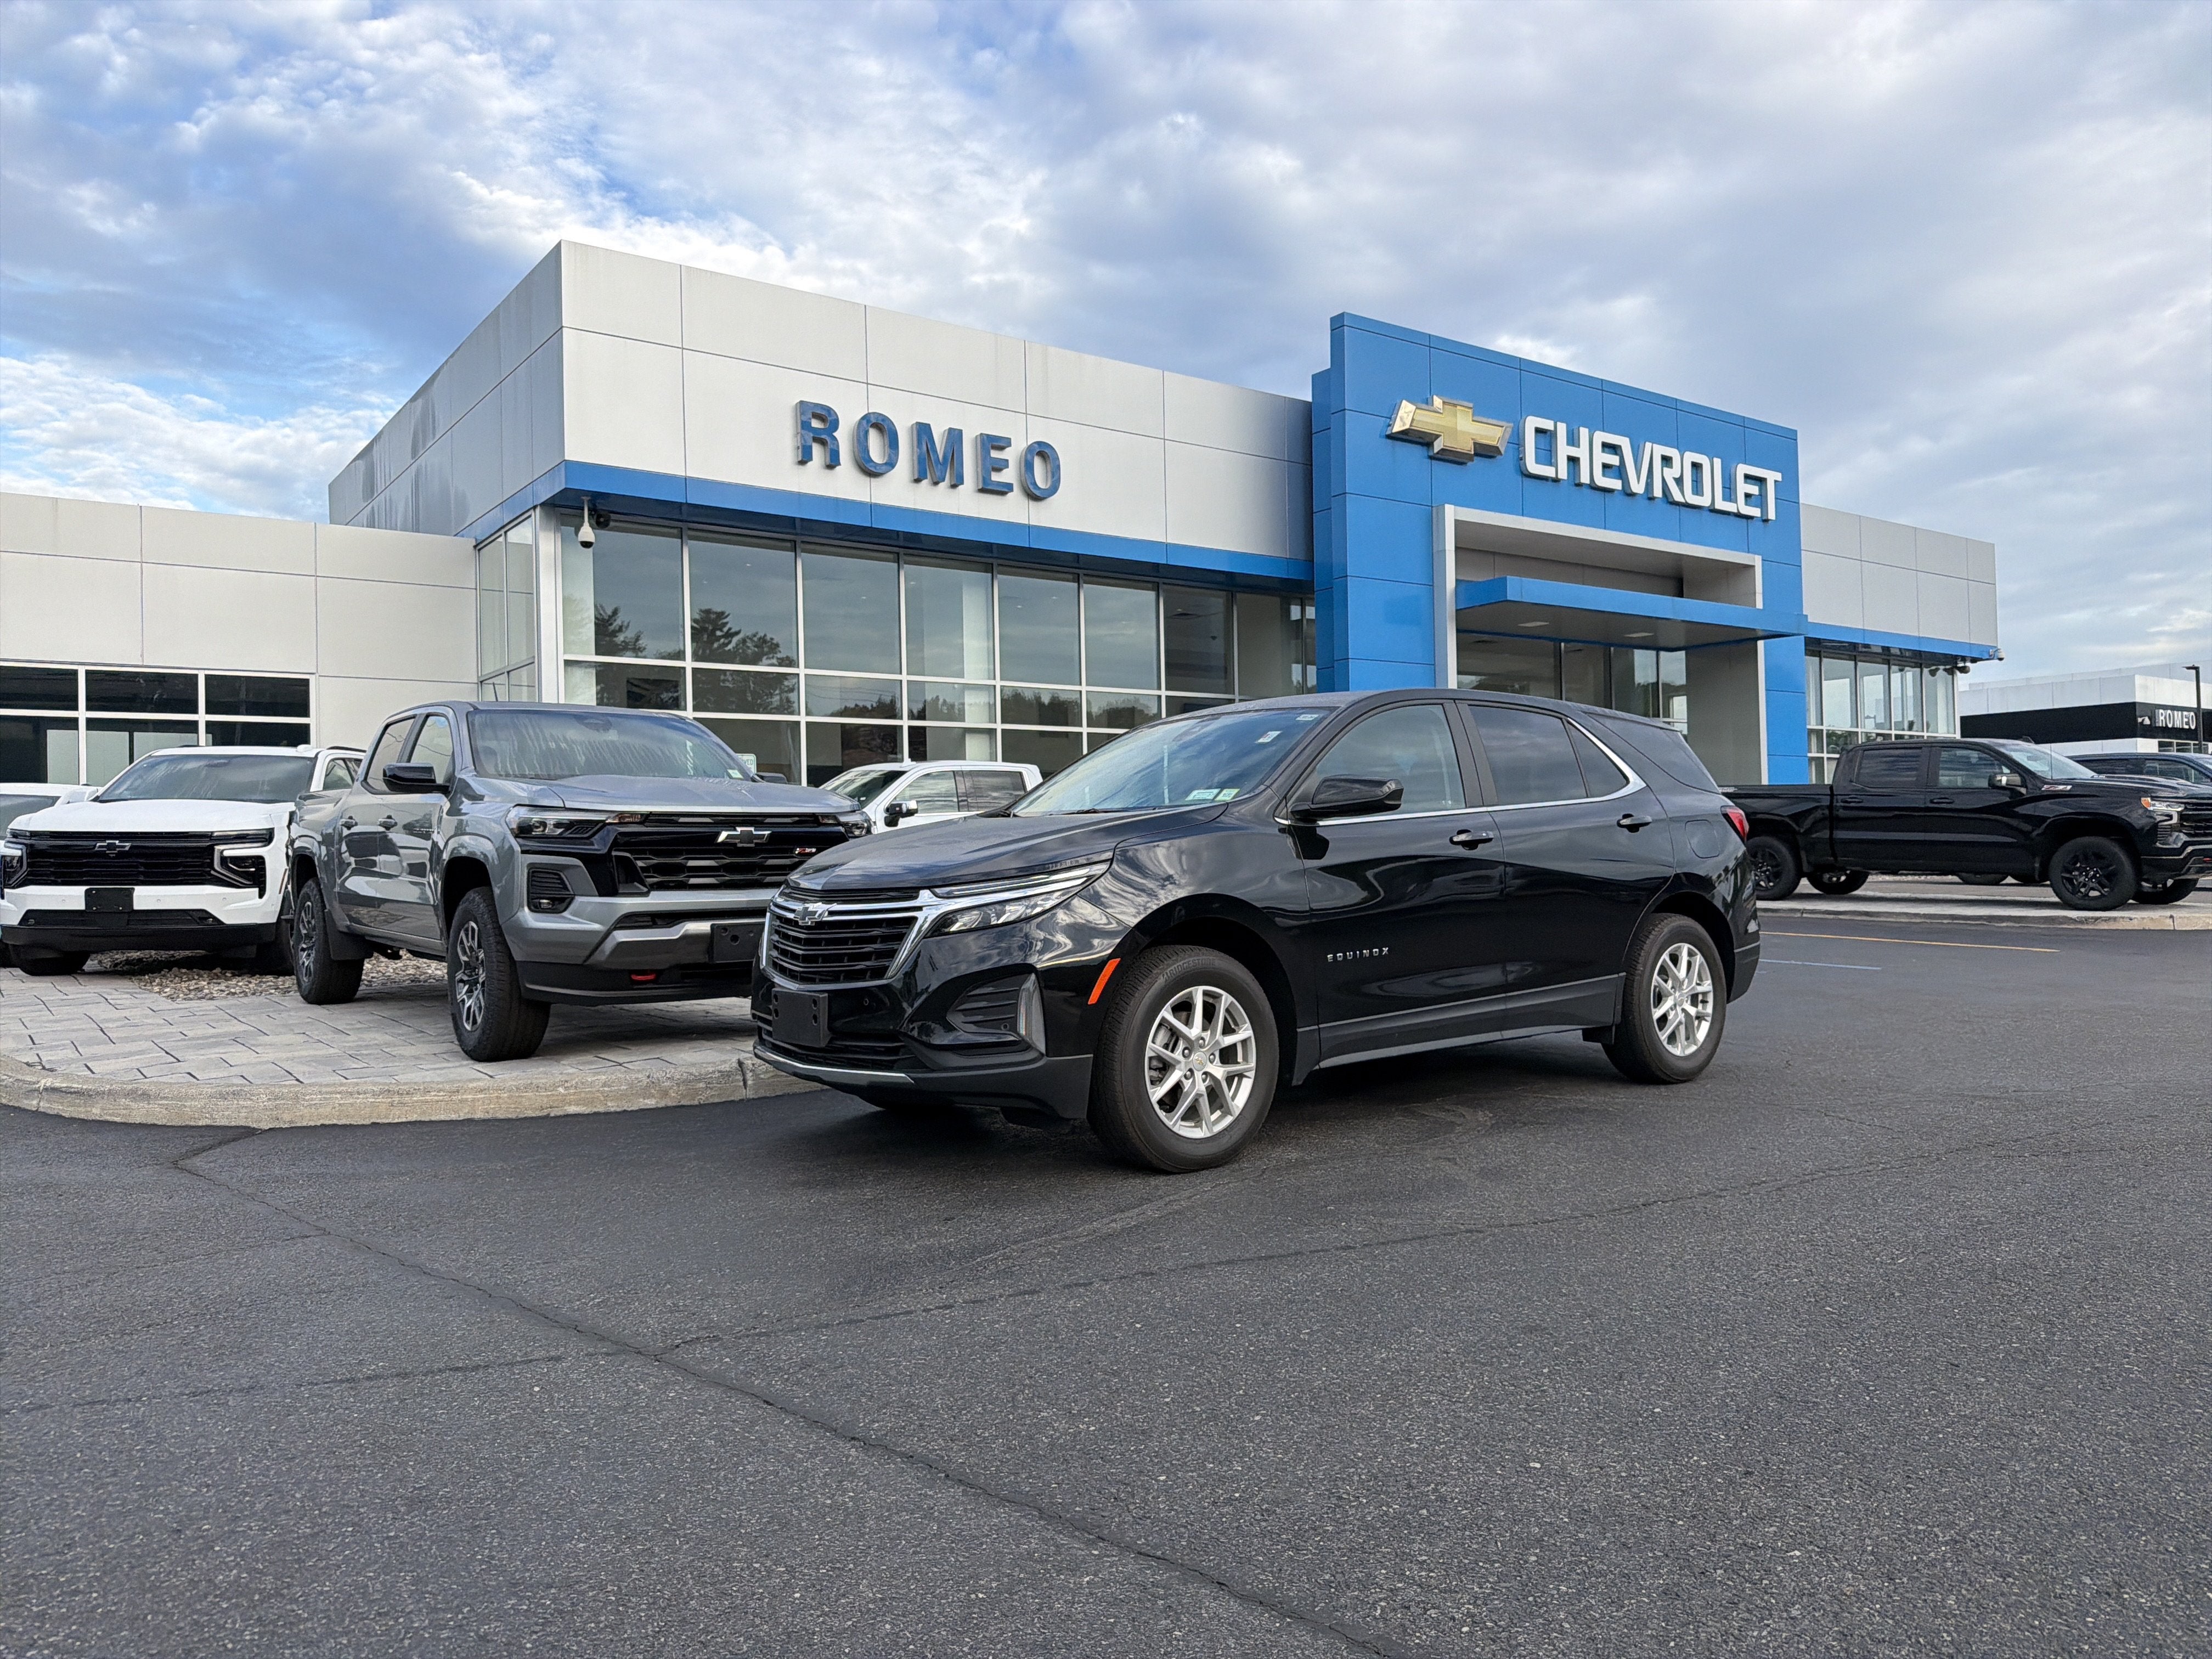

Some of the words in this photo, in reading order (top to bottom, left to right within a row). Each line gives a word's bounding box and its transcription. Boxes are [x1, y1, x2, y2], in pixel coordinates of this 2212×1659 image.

[796, 400, 1061, 500] ROMEO
[1521, 415, 1782, 521] CHEVROLET
[2155, 709, 2196, 730] ROMEO
[1327, 947, 1389, 962] EQUINOX
